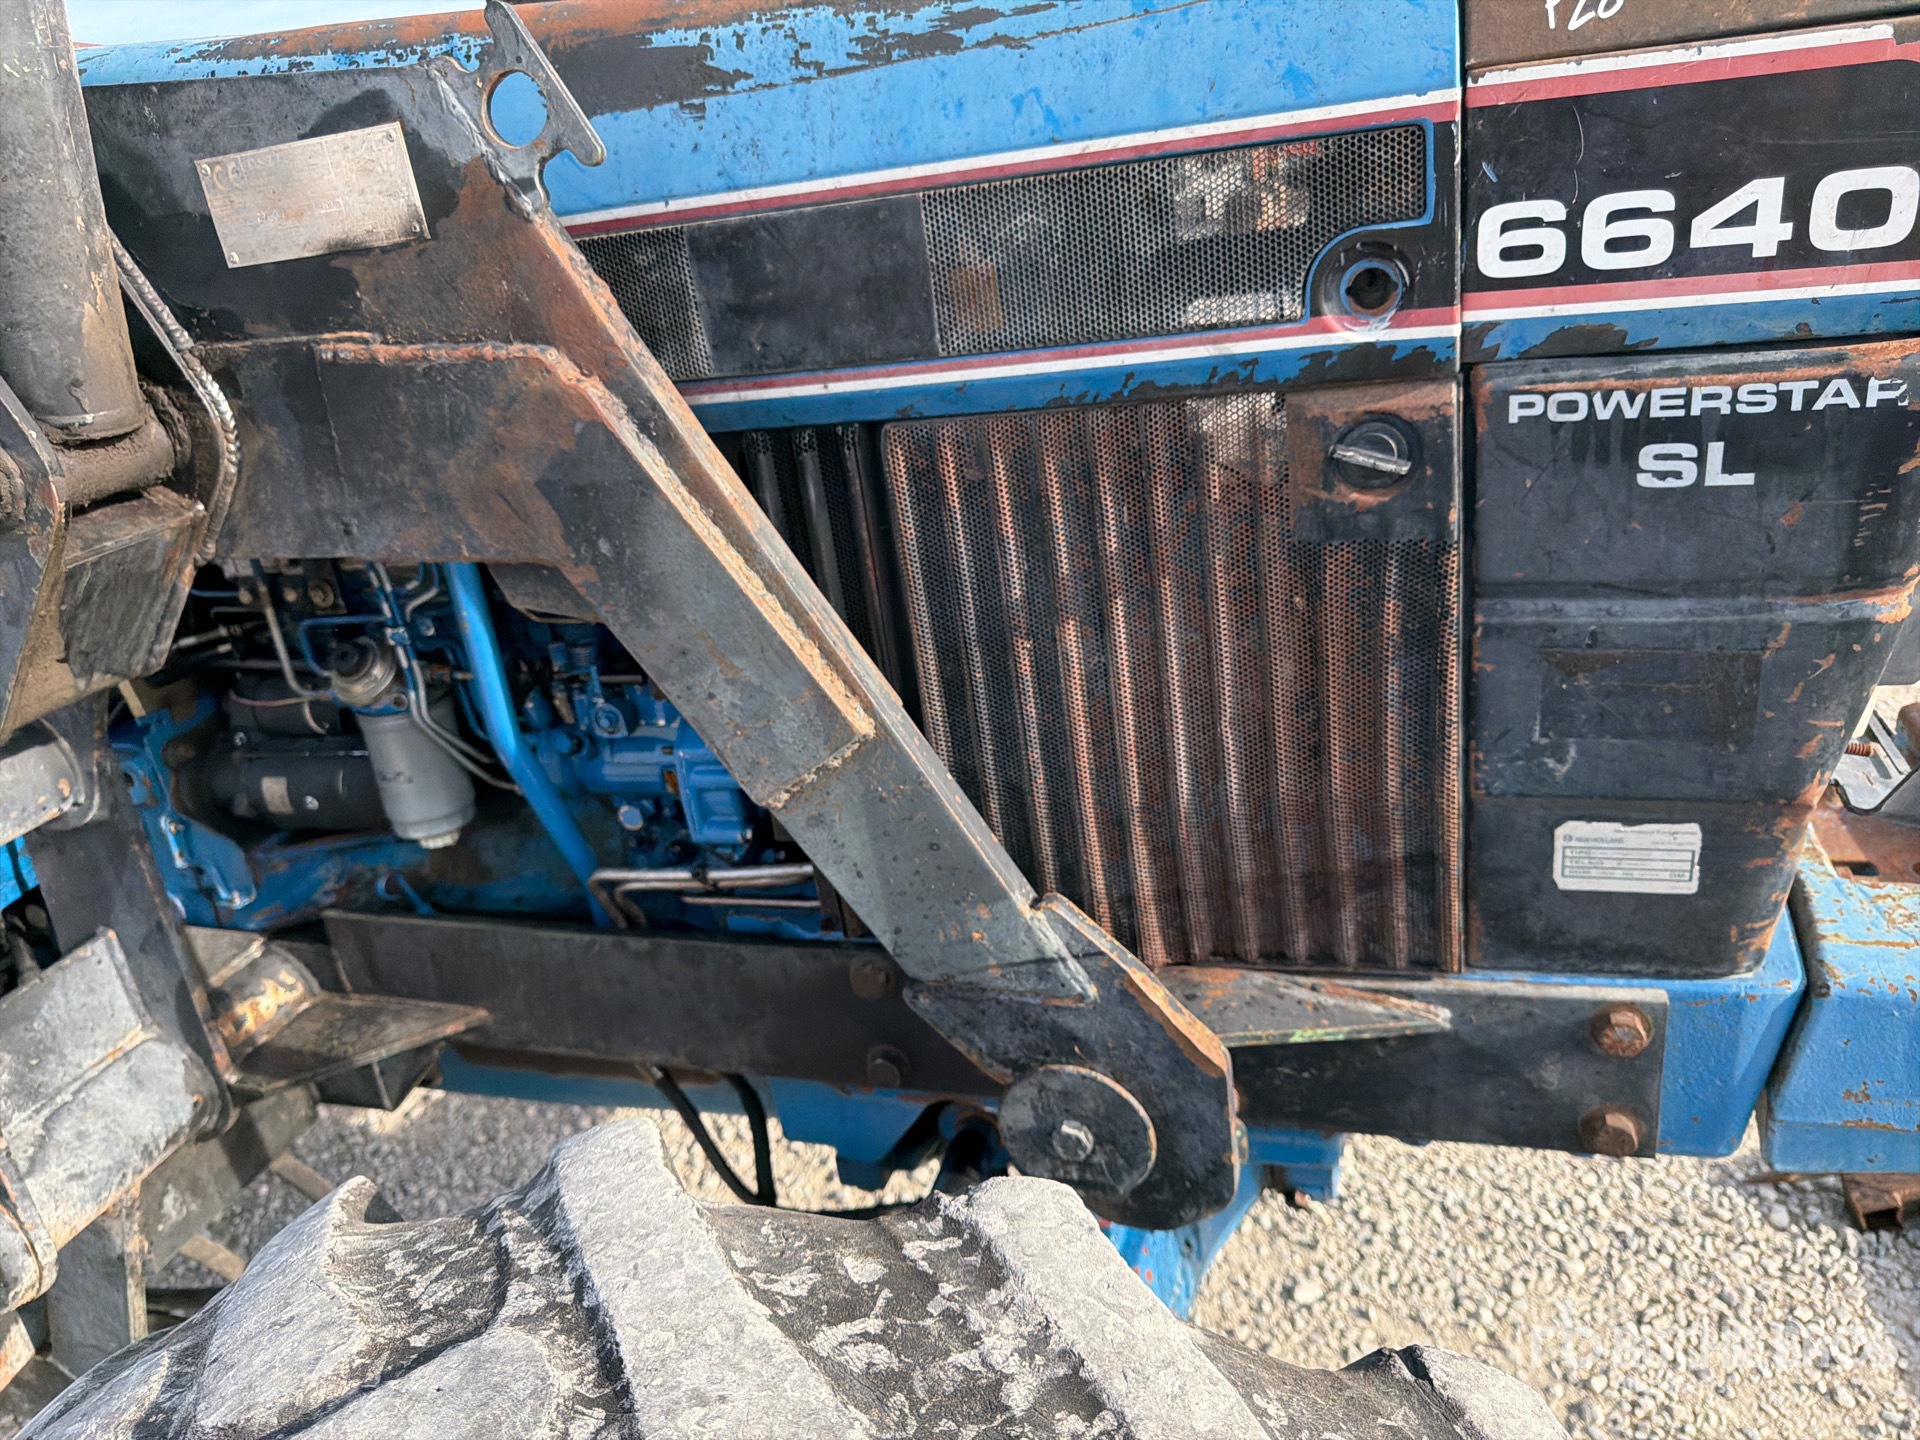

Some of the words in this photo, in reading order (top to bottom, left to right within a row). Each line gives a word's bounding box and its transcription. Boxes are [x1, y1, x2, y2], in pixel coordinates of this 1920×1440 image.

[1477, 166, 1920, 279] 6640
[1508, 377, 1909, 424] POWERSTAR
[1635, 441, 1755, 488] SL
